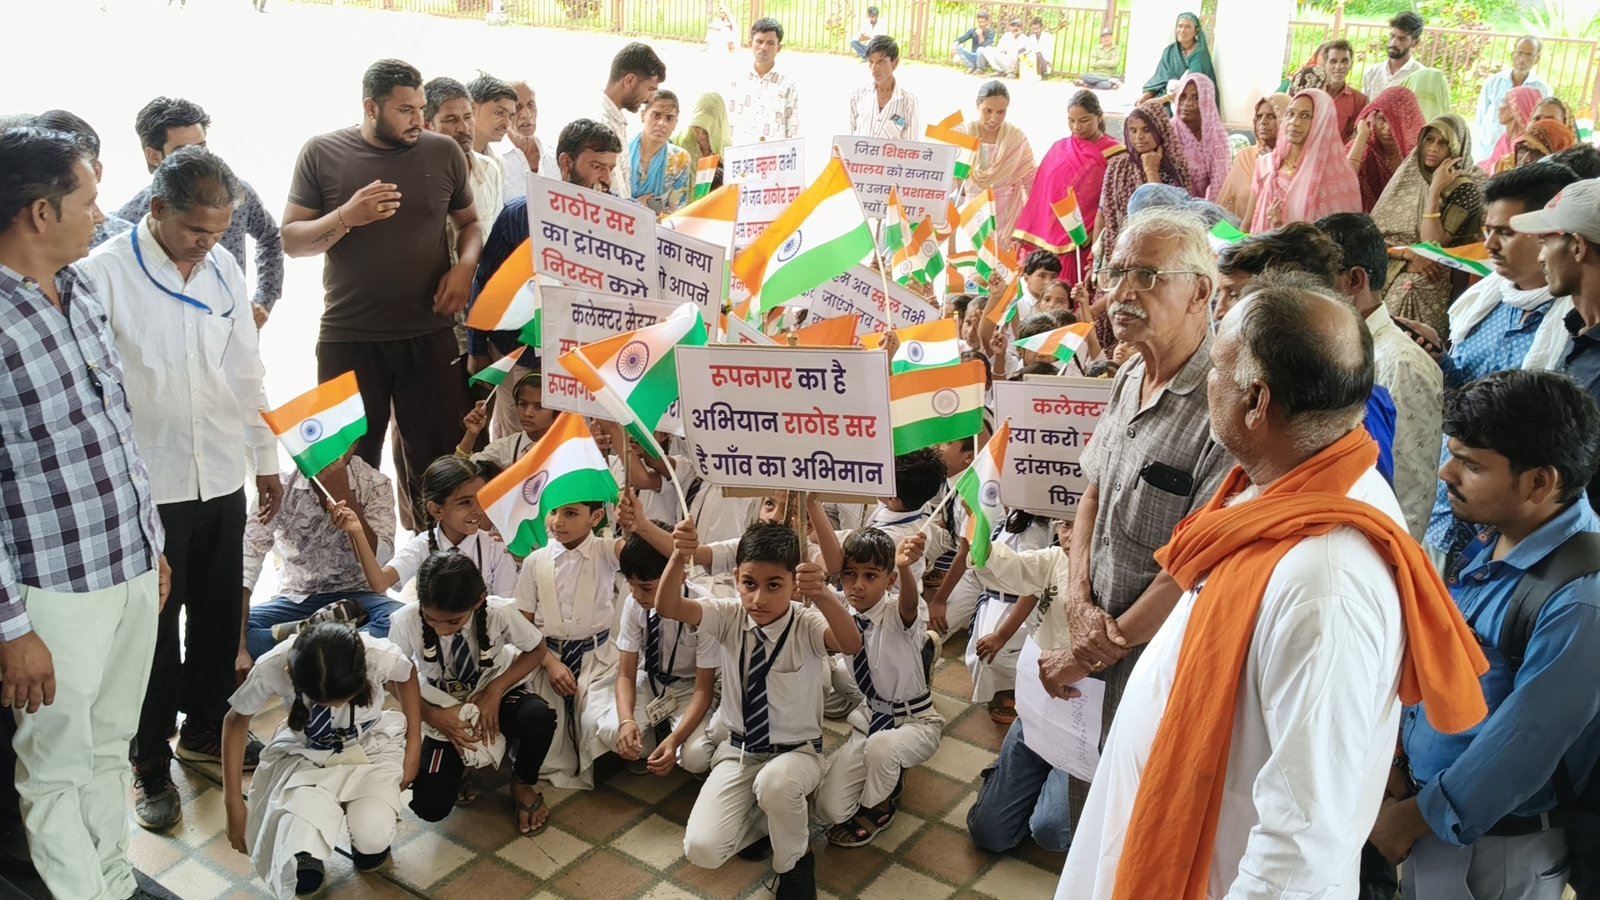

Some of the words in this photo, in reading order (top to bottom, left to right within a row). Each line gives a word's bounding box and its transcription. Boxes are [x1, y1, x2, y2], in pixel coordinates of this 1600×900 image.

[756, 155, 777, 179] स्कूल
[779, 147, 797, 171] तभी
[855, 141, 879, 156] जिस
[882, 143, 920, 160] शिक्षक
[922, 148, 933, 161] ने
[886, 164, 902, 178] को
[905, 167, 944, 181] सजाया
[902, 186, 946, 200] प्रशासन
[547, 190, 601, 224] राठोर
[604, 207, 636, 235] सर
[540, 220, 569, 246] का
[572, 229, 646, 272] ट्रांसफर
[684, 247, 713, 273] क्या
[541, 247, 604, 290] निरस्त
[607, 274, 649, 298] करो
[669, 276, 710, 306] आपने
[571, 299, 622, 332] कलेक्टर
[709, 365, 792, 390] रूपनगर
[796, 368, 827, 391] का
[831, 359, 847, 395] है
[692, 401, 778, 433] अभियान
[782, 407, 840, 437] राठोड
[843, 415, 877, 439] सर
[1040, 426, 1079, 448] करो
[695, 444, 709, 476] है
[711, 444, 752, 477] गाँव
[756, 455, 787, 478] का
[791, 450, 884, 485] अभिमान
[1013, 454, 1082, 478] ट्रांसफर
[1048, 485, 1084, 506] फि
